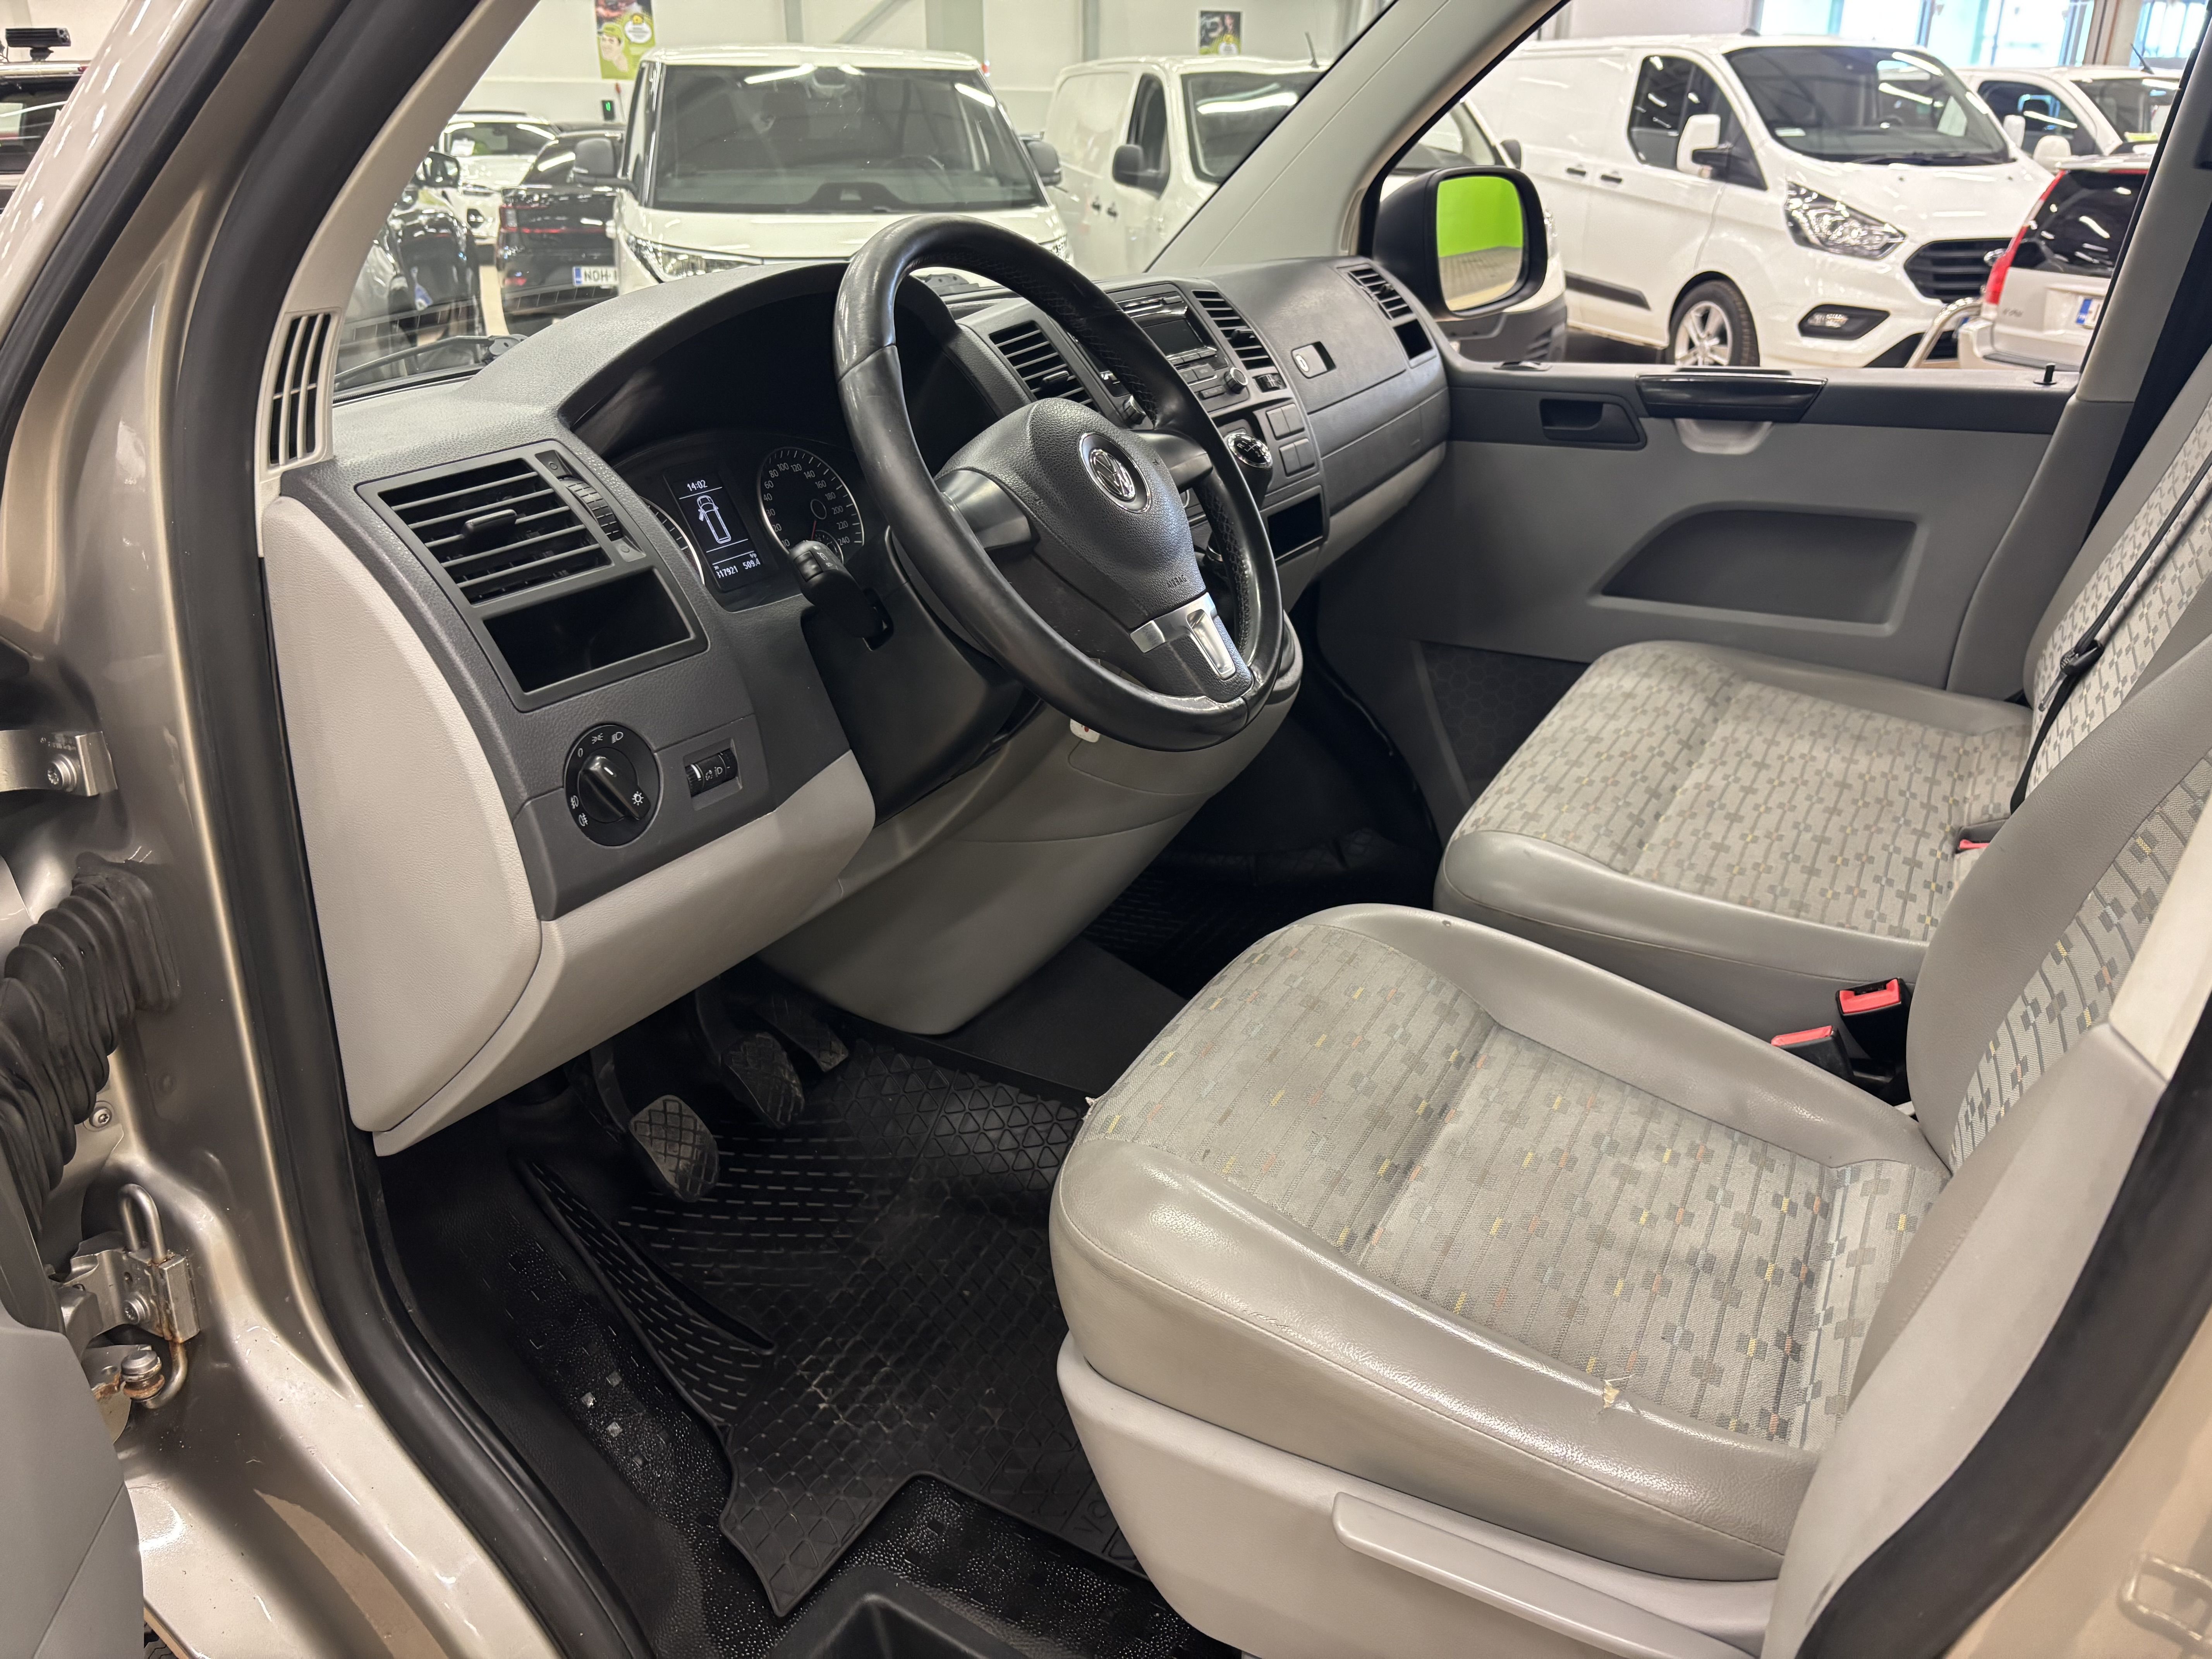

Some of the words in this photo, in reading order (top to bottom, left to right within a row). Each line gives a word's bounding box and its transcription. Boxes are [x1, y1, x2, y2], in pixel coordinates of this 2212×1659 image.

[777, 463, 789, 471] 100
[791, 464, 802, 472] 120
[769, 469, 779, 477] 80
[804, 470, 815, 479] 140
[687, 480, 708, 491] 14:02
[764, 480, 774, 488] 60
[815, 480, 826, 488] 160
[763, 493, 773, 501] 40
[825, 492, 836, 500] 180
[766, 508, 775, 517] 30
[831, 505, 843, 514] 200
[772, 524, 782, 532] 20
[836, 520, 848, 530] 220
[781, 539, 790, 547] 10
[837, 536, 850, 545] 240
[742, 558, 761, 569] 509.4
